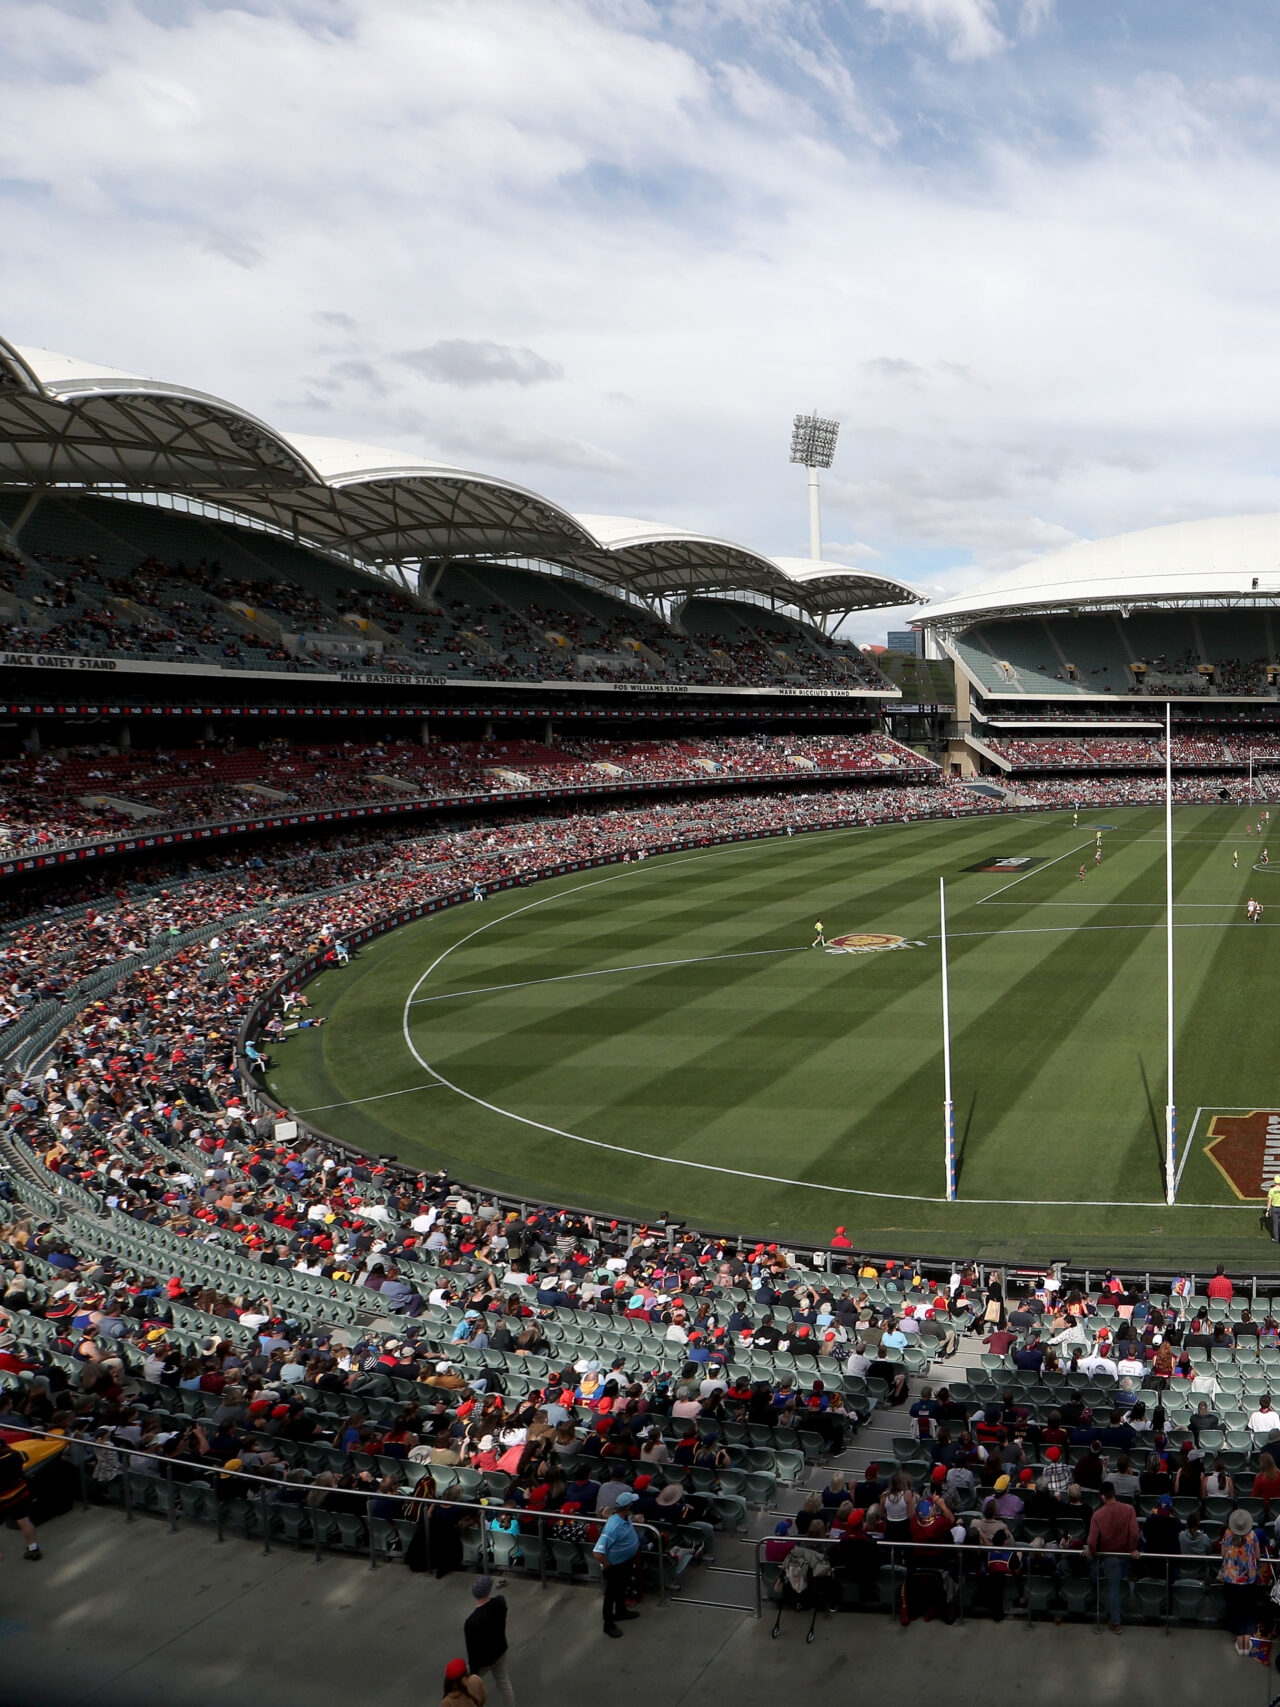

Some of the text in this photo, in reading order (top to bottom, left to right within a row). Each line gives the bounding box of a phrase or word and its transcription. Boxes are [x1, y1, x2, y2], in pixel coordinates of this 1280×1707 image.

[2, 654, 117, 670] JACK OATEY STAND
[340, 673, 446, 685] MAX BASHEER STAND
